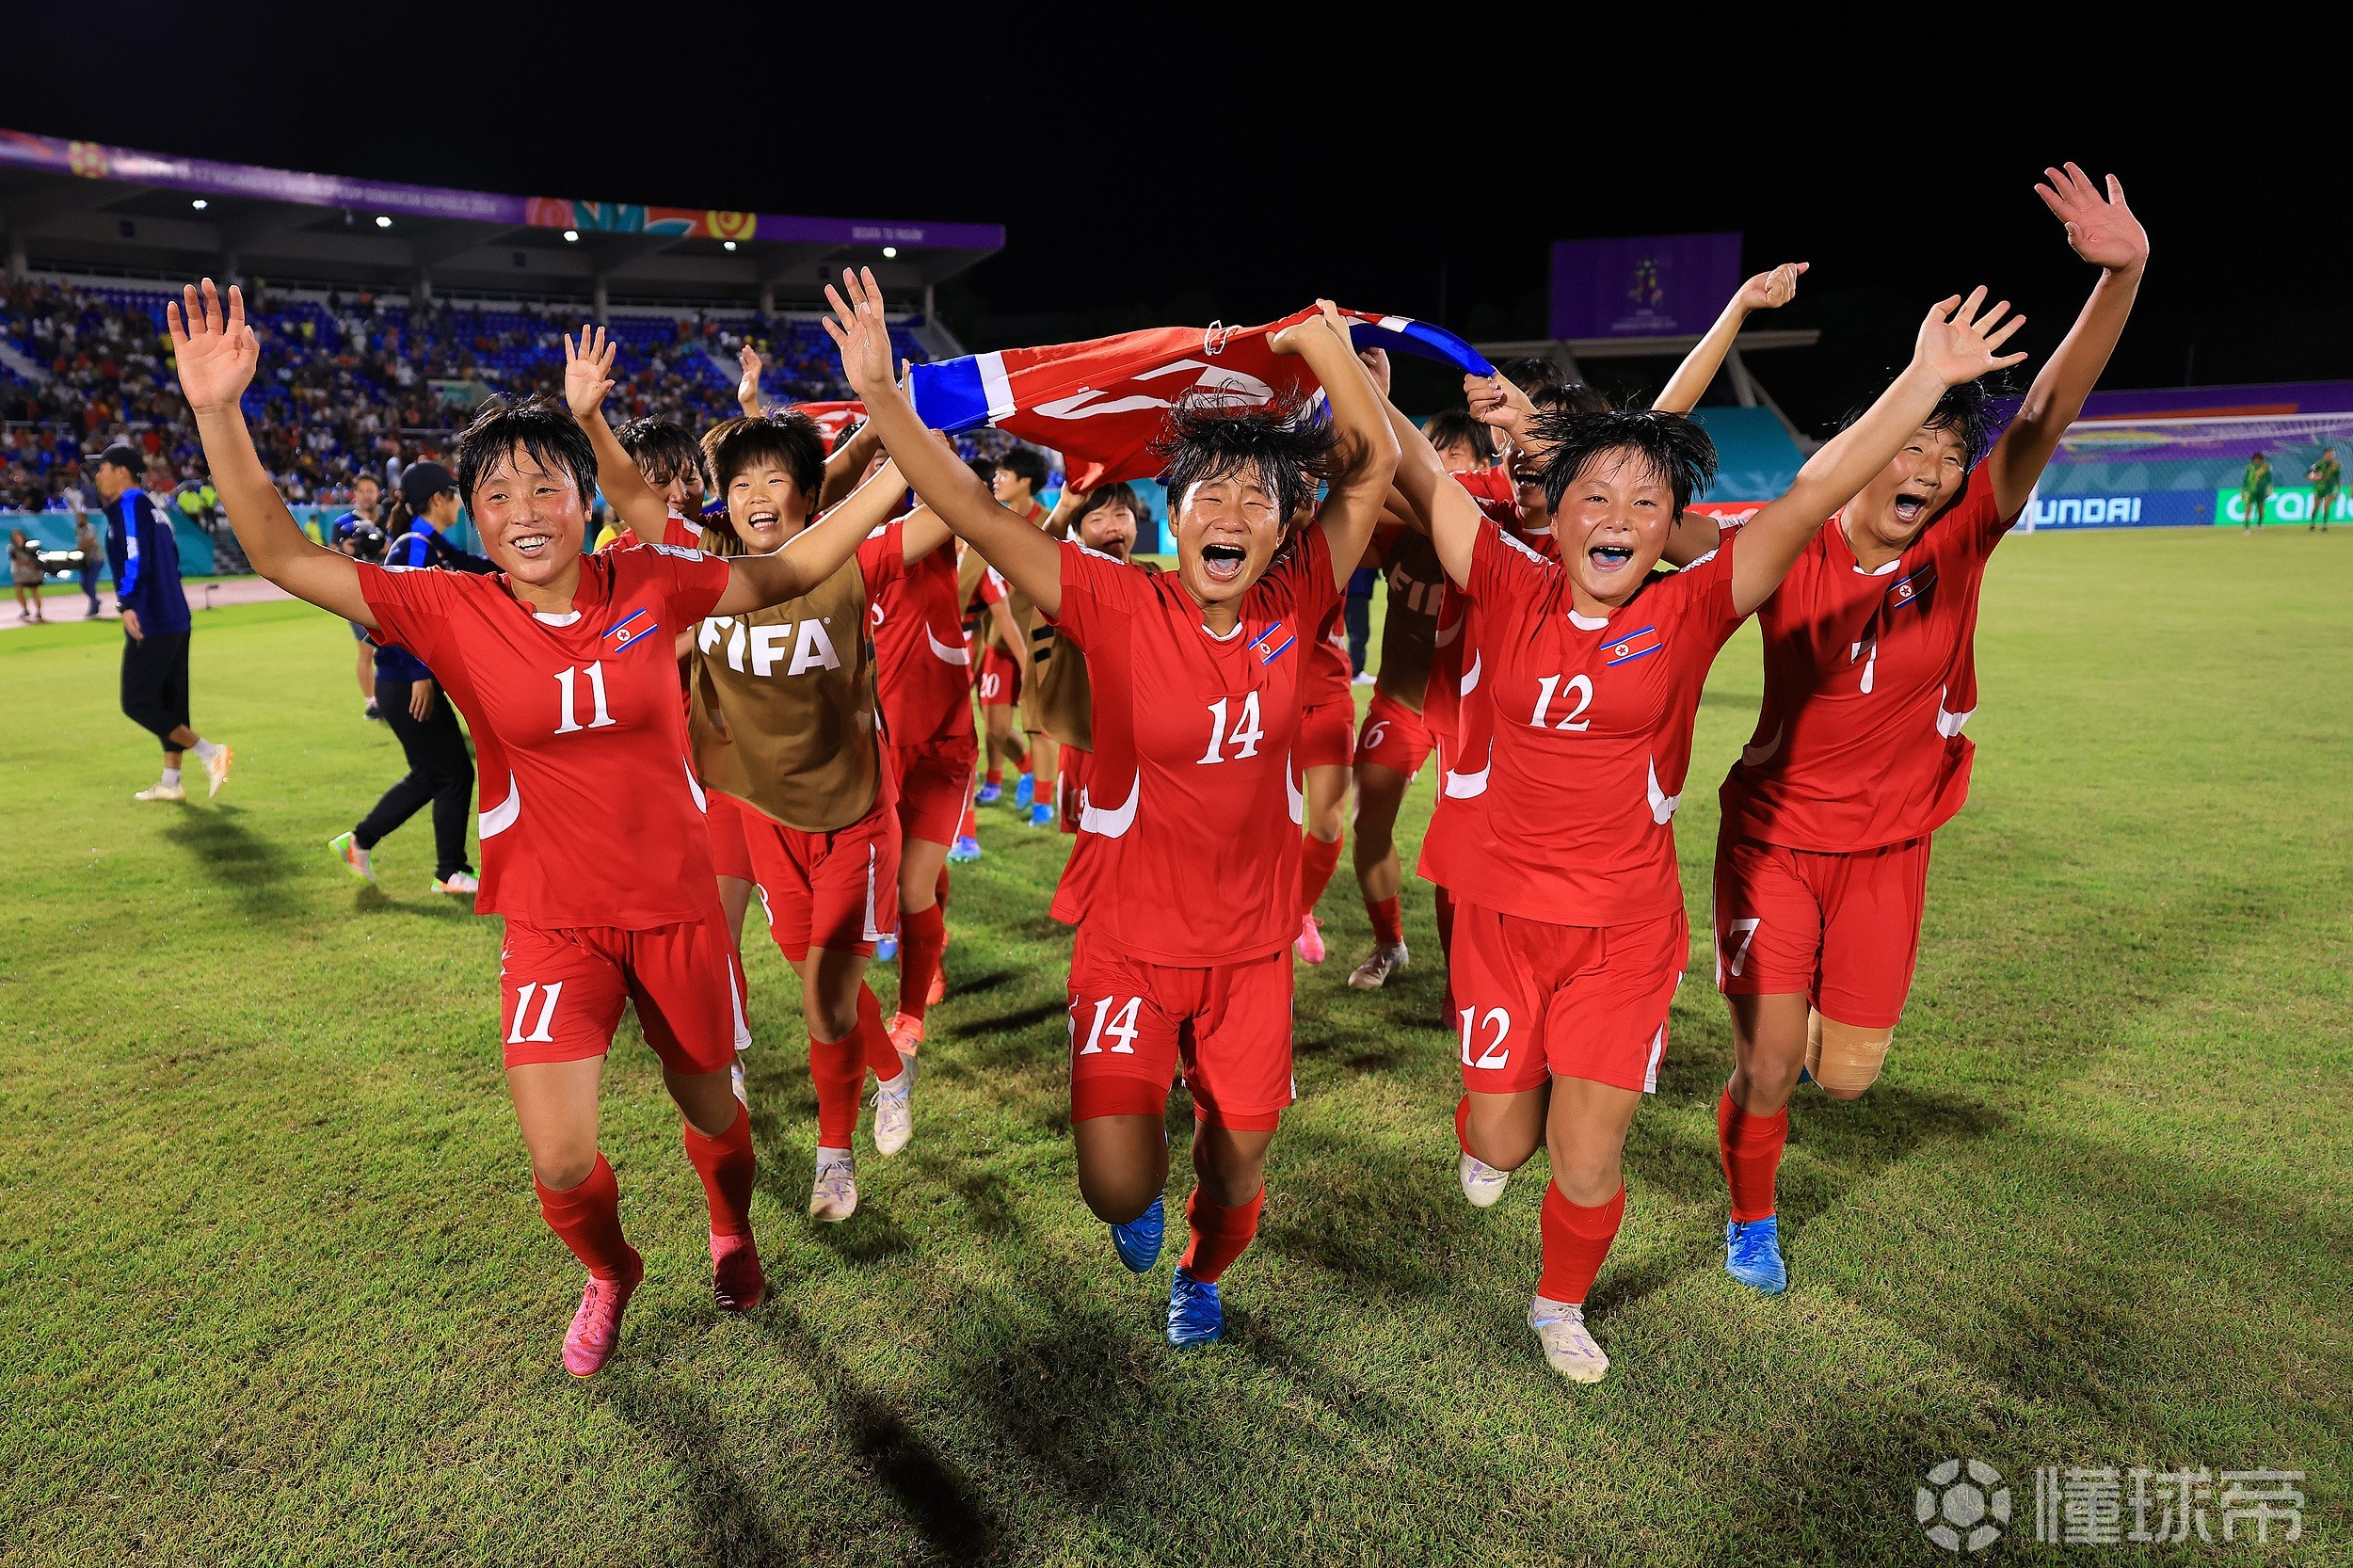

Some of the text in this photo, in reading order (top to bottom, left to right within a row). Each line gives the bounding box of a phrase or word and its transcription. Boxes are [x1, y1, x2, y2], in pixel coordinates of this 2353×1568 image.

[2019, 497, 2142, 525] UNDAI
[697, 616, 840, 677] FIFA
[1850, 632, 1878, 694] 7
[553, 659, 616, 735] 11
[1195, 690, 1264, 765] 14
[1529, 673, 1594, 732] 12
[1364, 720, 1391, 749] 6
[1729, 918, 1760, 977] 7
[506, 980, 564, 1045] 11
[1080, 995, 1144, 1056] 14
[1459, 1004, 1512, 1070] 12
